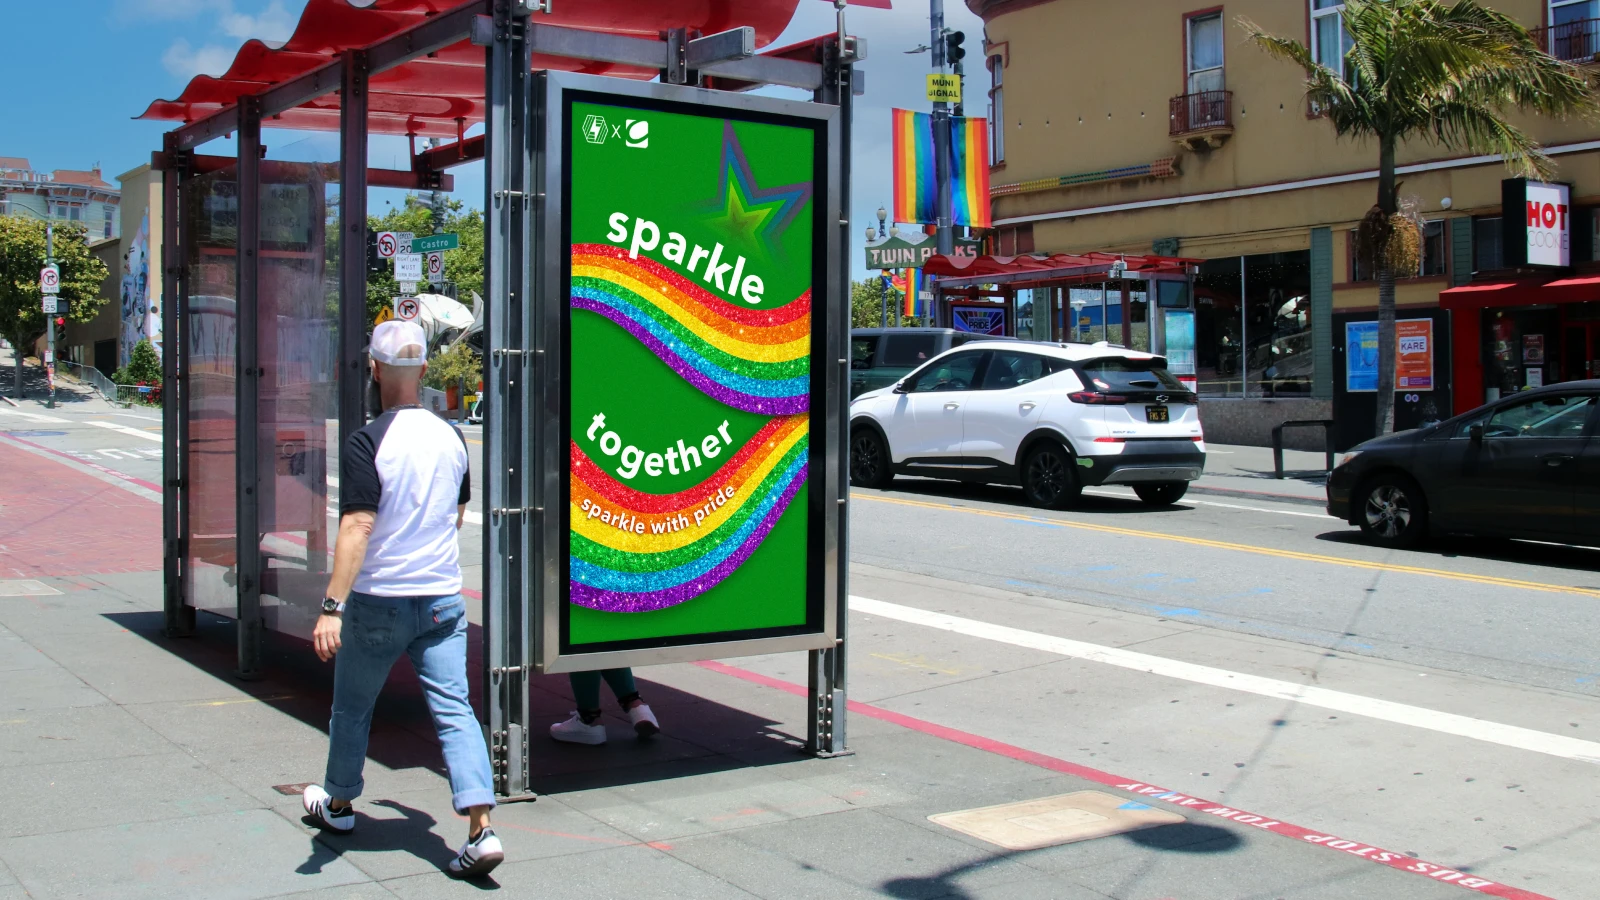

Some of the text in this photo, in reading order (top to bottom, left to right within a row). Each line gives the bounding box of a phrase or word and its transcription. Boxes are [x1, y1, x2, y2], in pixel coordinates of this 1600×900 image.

[932, 79, 954, 87] MUNI
[1526, 201, 1567, 230] HOT
[400, 245, 412, 254] 20
[421, 240, 449, 249] Castro
[1527, 230, 1568, 250] COOKIE
[606, 211, 765, 304] sparkle
[870, 248, 915, 265] TWIN
[969, 321, 989, 329] PRIDE
[1401, 342, 1425, 351] KARE
[586, 412, 733, 480] together
[581, 485, 735, 535] sparkle with pride
[1116, 783, 1281, 828] TOW AWAY
[1303, 834, 1494, 889] BUS STOP
